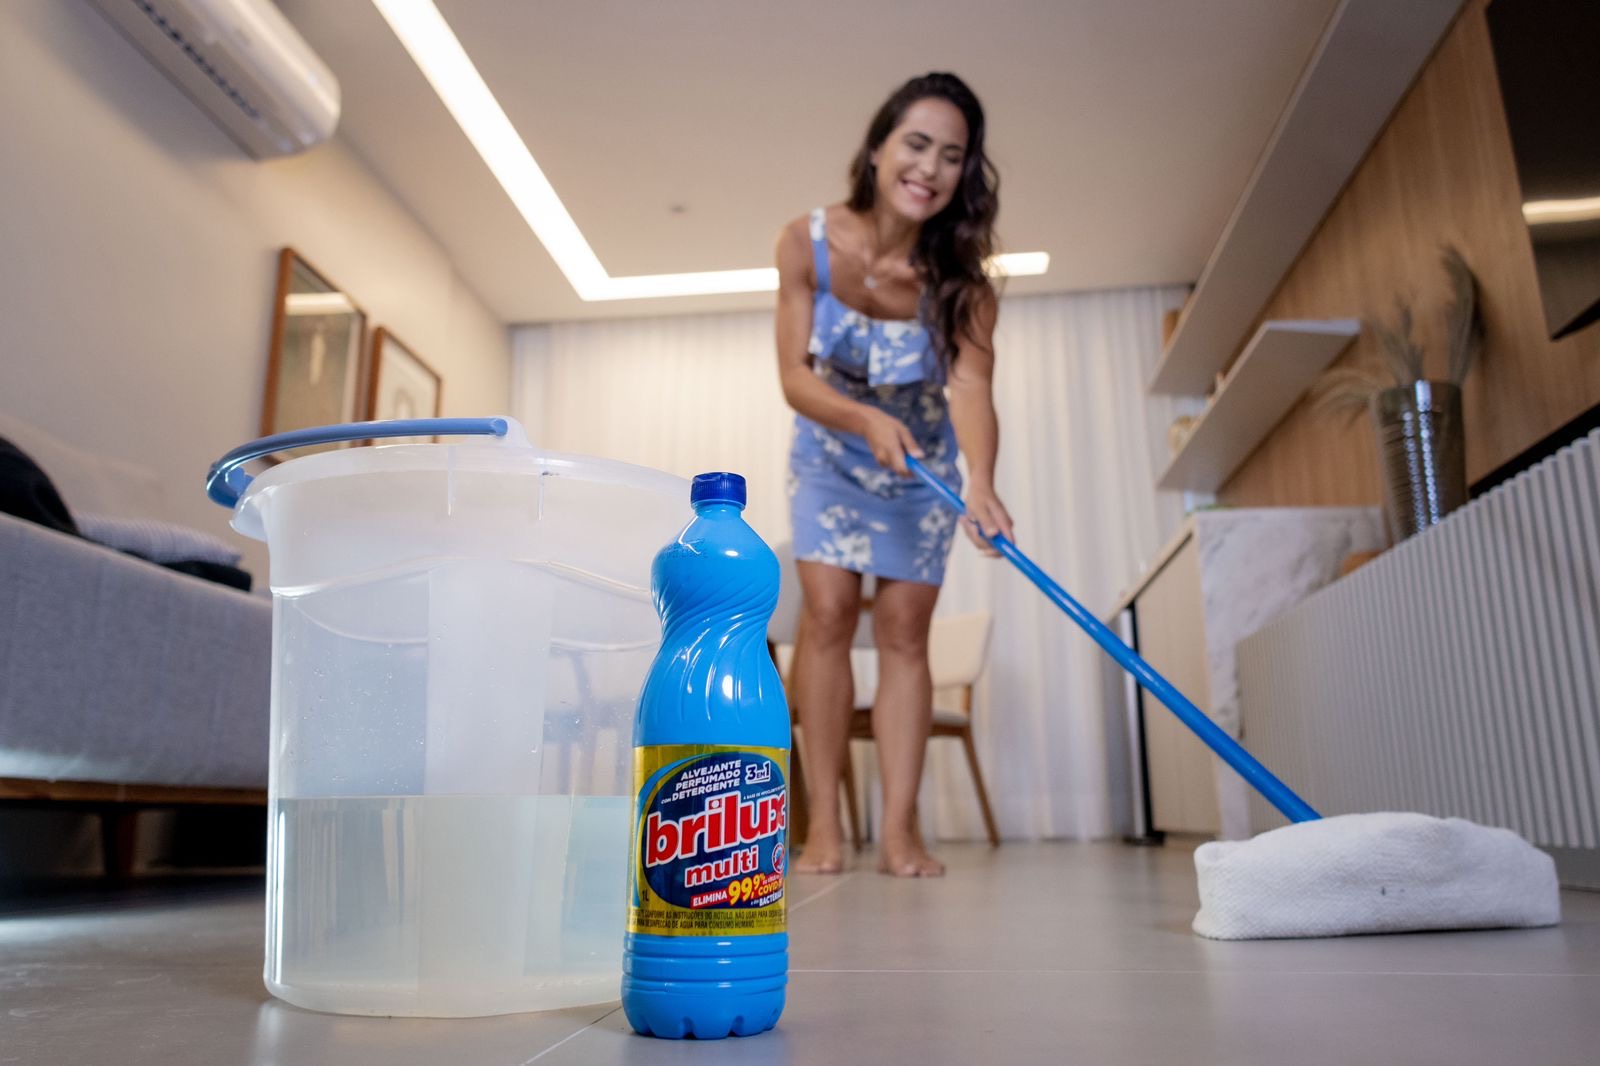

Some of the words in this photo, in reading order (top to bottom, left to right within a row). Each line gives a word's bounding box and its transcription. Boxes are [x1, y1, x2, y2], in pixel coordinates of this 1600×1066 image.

[675, 769, 741, 791] PERFUMADO
[681, 760, 741, 781] ALVEJANTE
[672, 778, 740, 801] DETERGENTE
[646, 790, 785, 867] brilux
[685, 845, 759, 888] multi
[642, 889, 649, 901] 1L
[693, 890, 728, 907] ELIMINA
